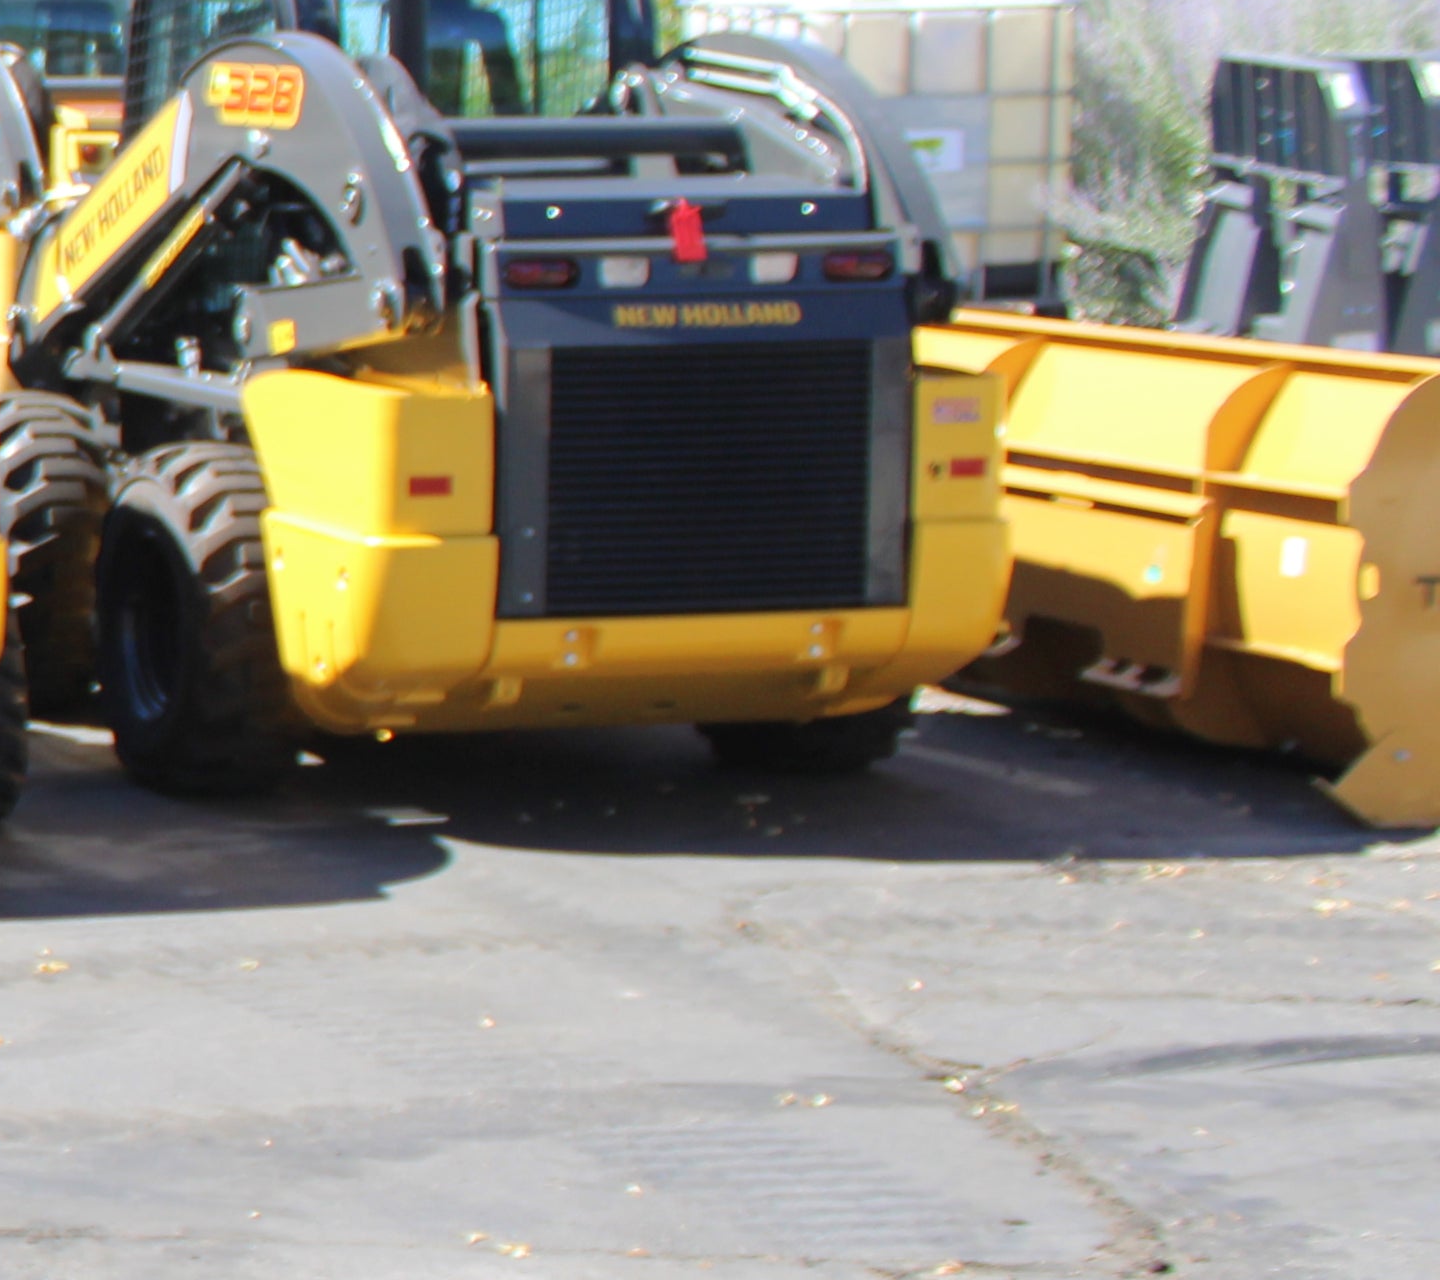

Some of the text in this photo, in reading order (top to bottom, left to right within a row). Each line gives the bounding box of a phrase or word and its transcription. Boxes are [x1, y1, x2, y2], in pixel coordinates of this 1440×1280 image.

[97, 146, 164, 237] HOLLAND
[614, 301, 803, 327] NEW HOLLAND
